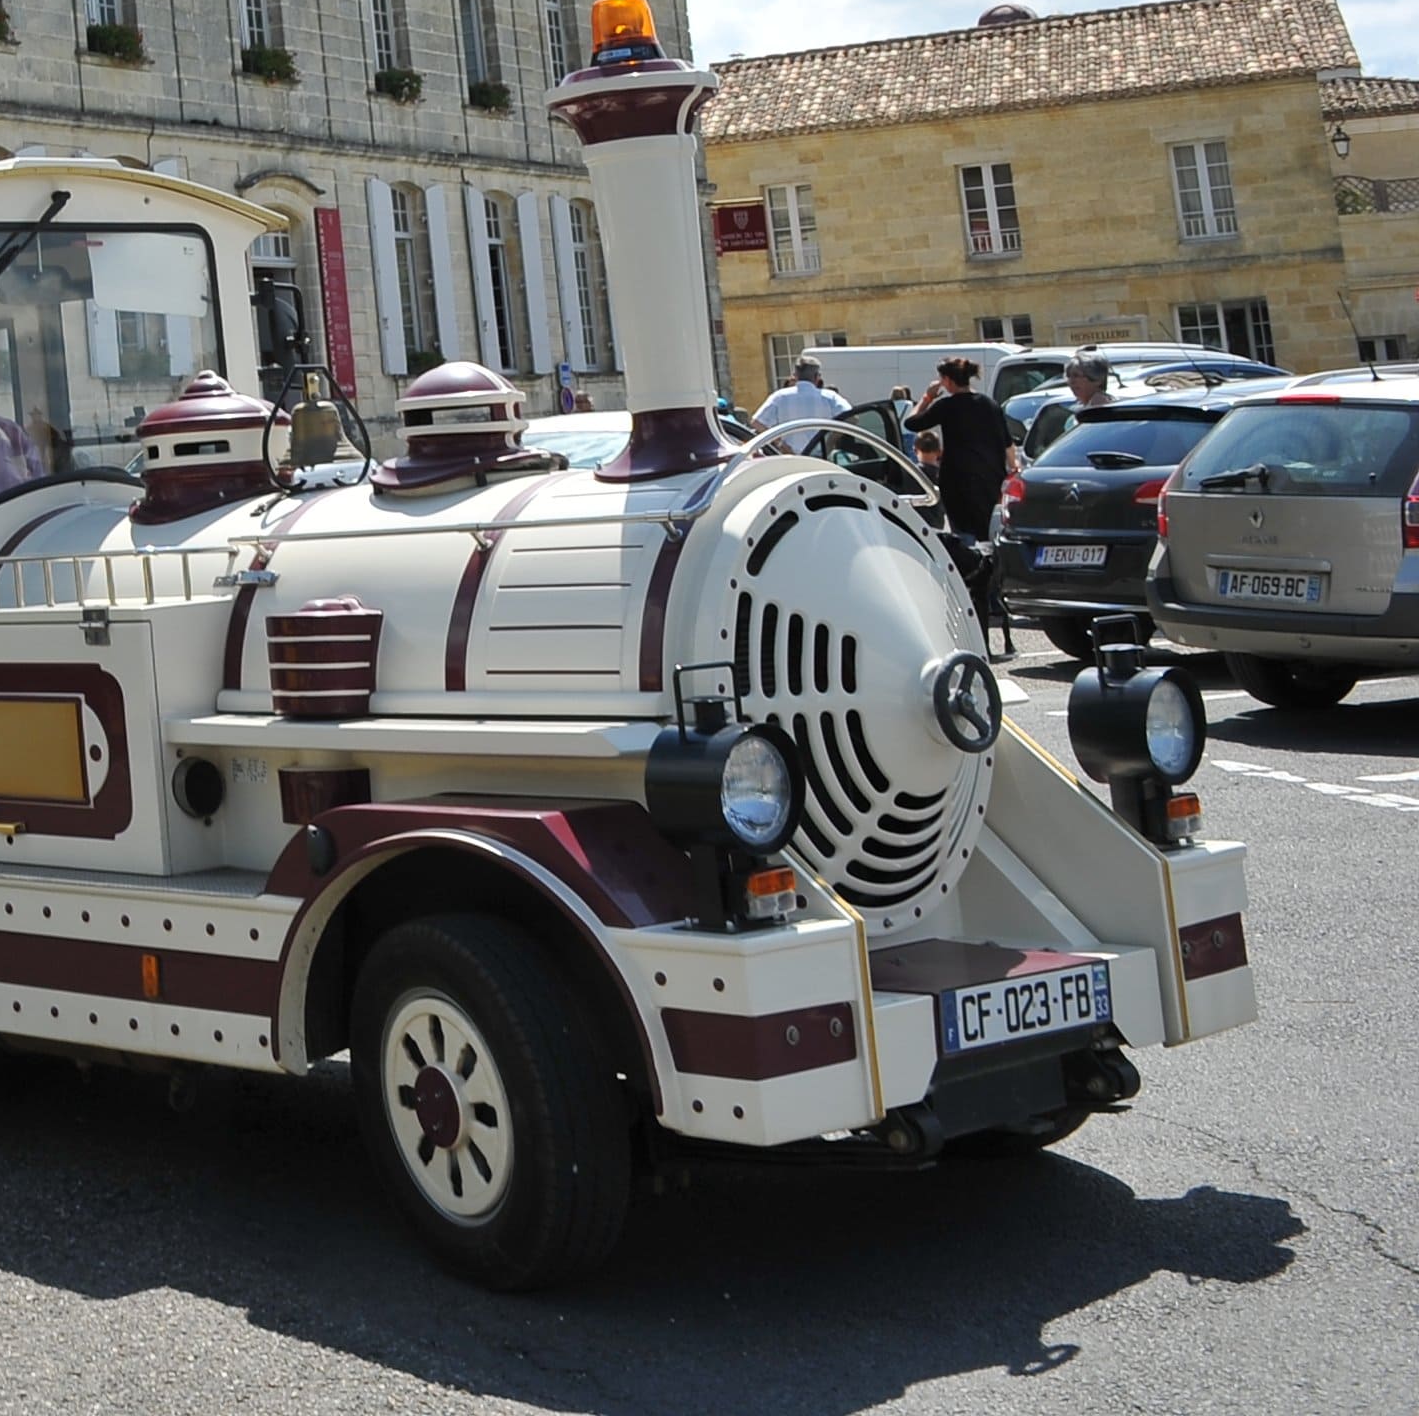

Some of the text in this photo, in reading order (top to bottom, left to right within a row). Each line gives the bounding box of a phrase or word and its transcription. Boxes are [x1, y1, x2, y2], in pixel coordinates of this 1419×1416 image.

[1230, 574, 1306, 598] AF-069-BC
[961, 972, 1092, 1043] CF-023-FB
[1095, 994, 1110, 1019] 33
